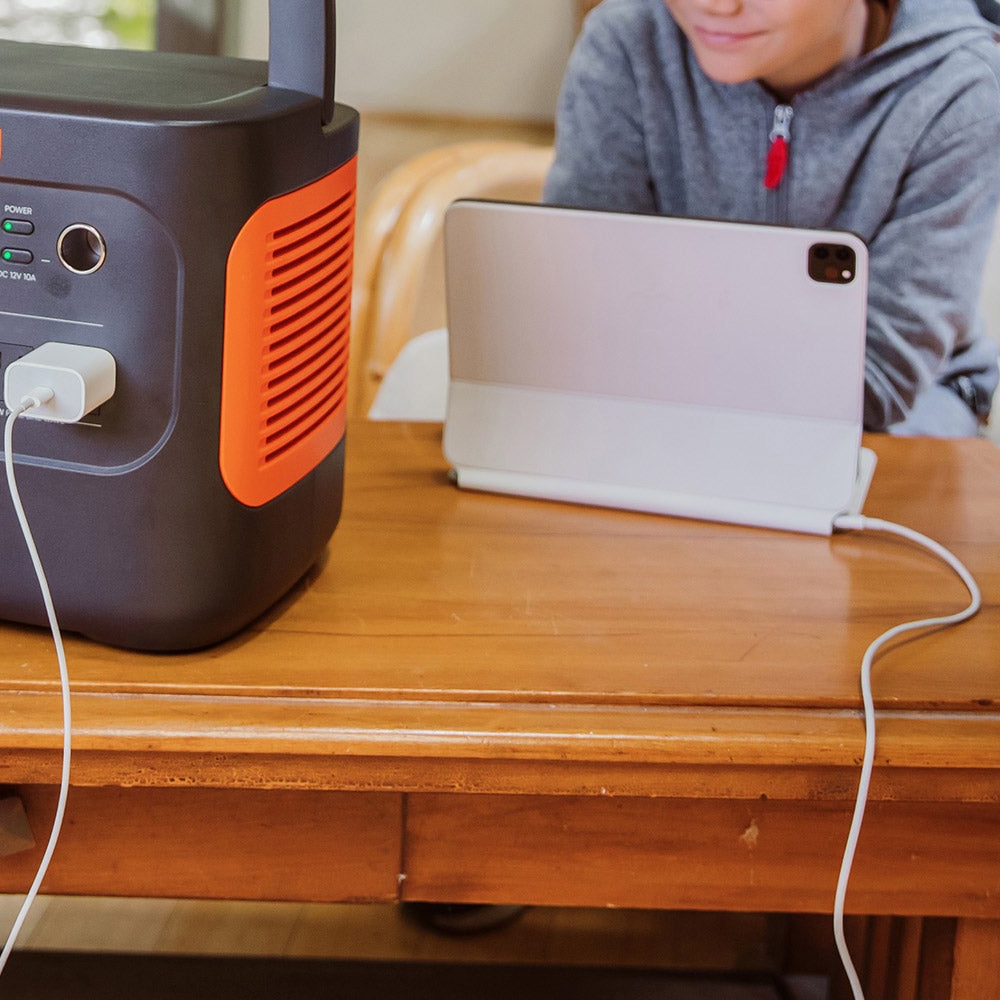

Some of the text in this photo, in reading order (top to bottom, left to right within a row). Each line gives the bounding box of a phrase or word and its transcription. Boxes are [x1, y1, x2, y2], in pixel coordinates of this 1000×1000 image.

[4, 204, 33, 215] POWER
[10, 271, 22, 280] 12V
[23, 273, 36, 282] 10A
